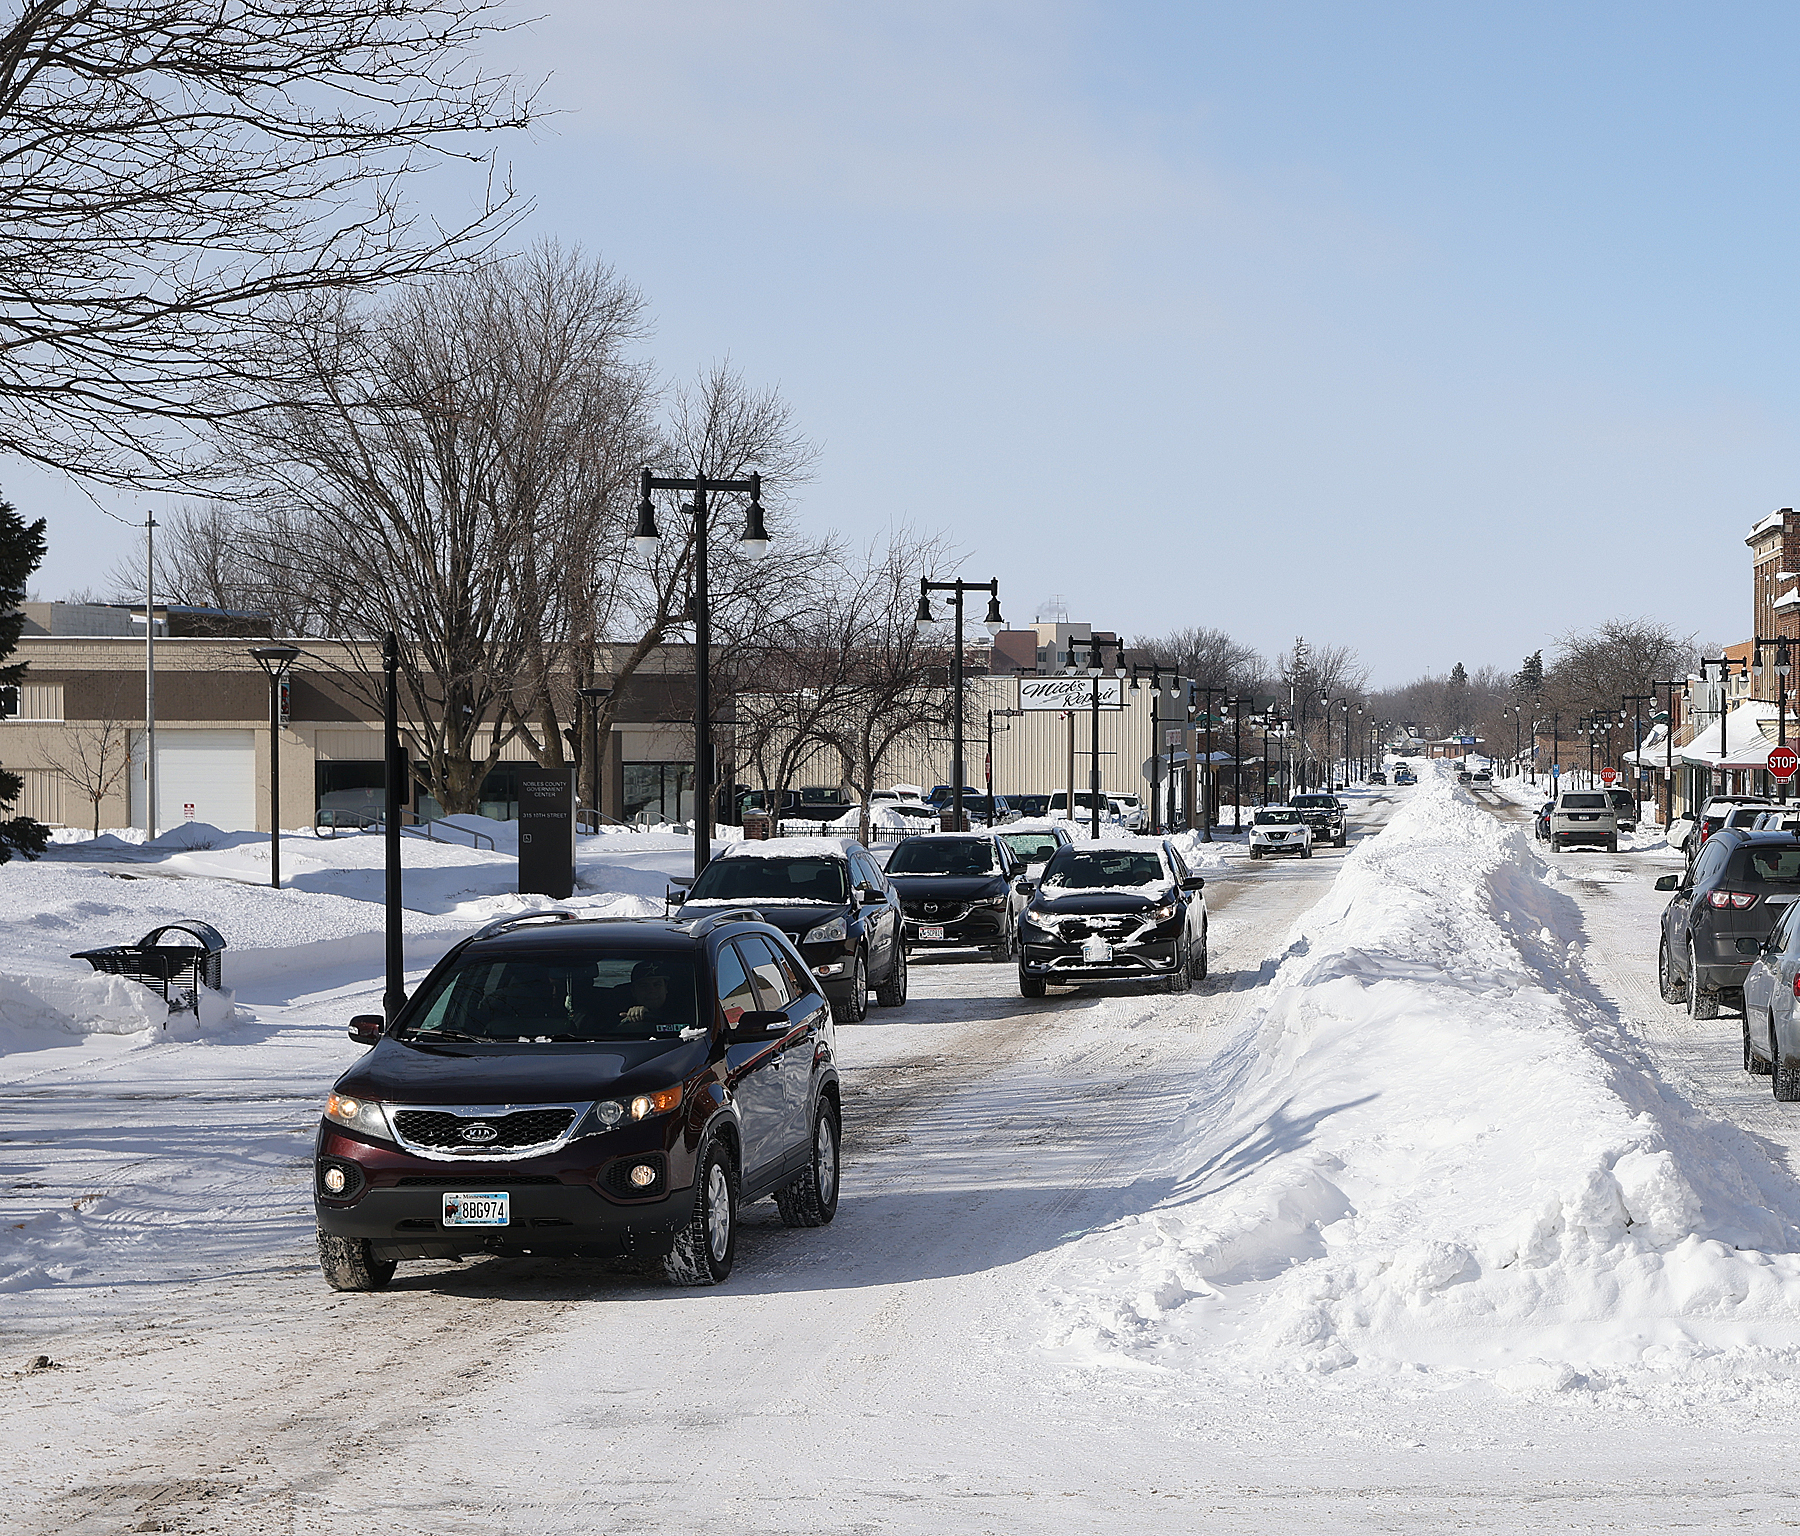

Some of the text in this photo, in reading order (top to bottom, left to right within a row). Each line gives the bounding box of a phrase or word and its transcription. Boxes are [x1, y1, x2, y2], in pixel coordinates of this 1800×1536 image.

[1022, 680, 1086, 699] Mick's
[1062, 687, 1118, 708] Repir
[1769, 756, 1796, 769] STOP
[469, 1129, 491, 1137] KIA
[462, 1201, 505, 1219] 8BG974
